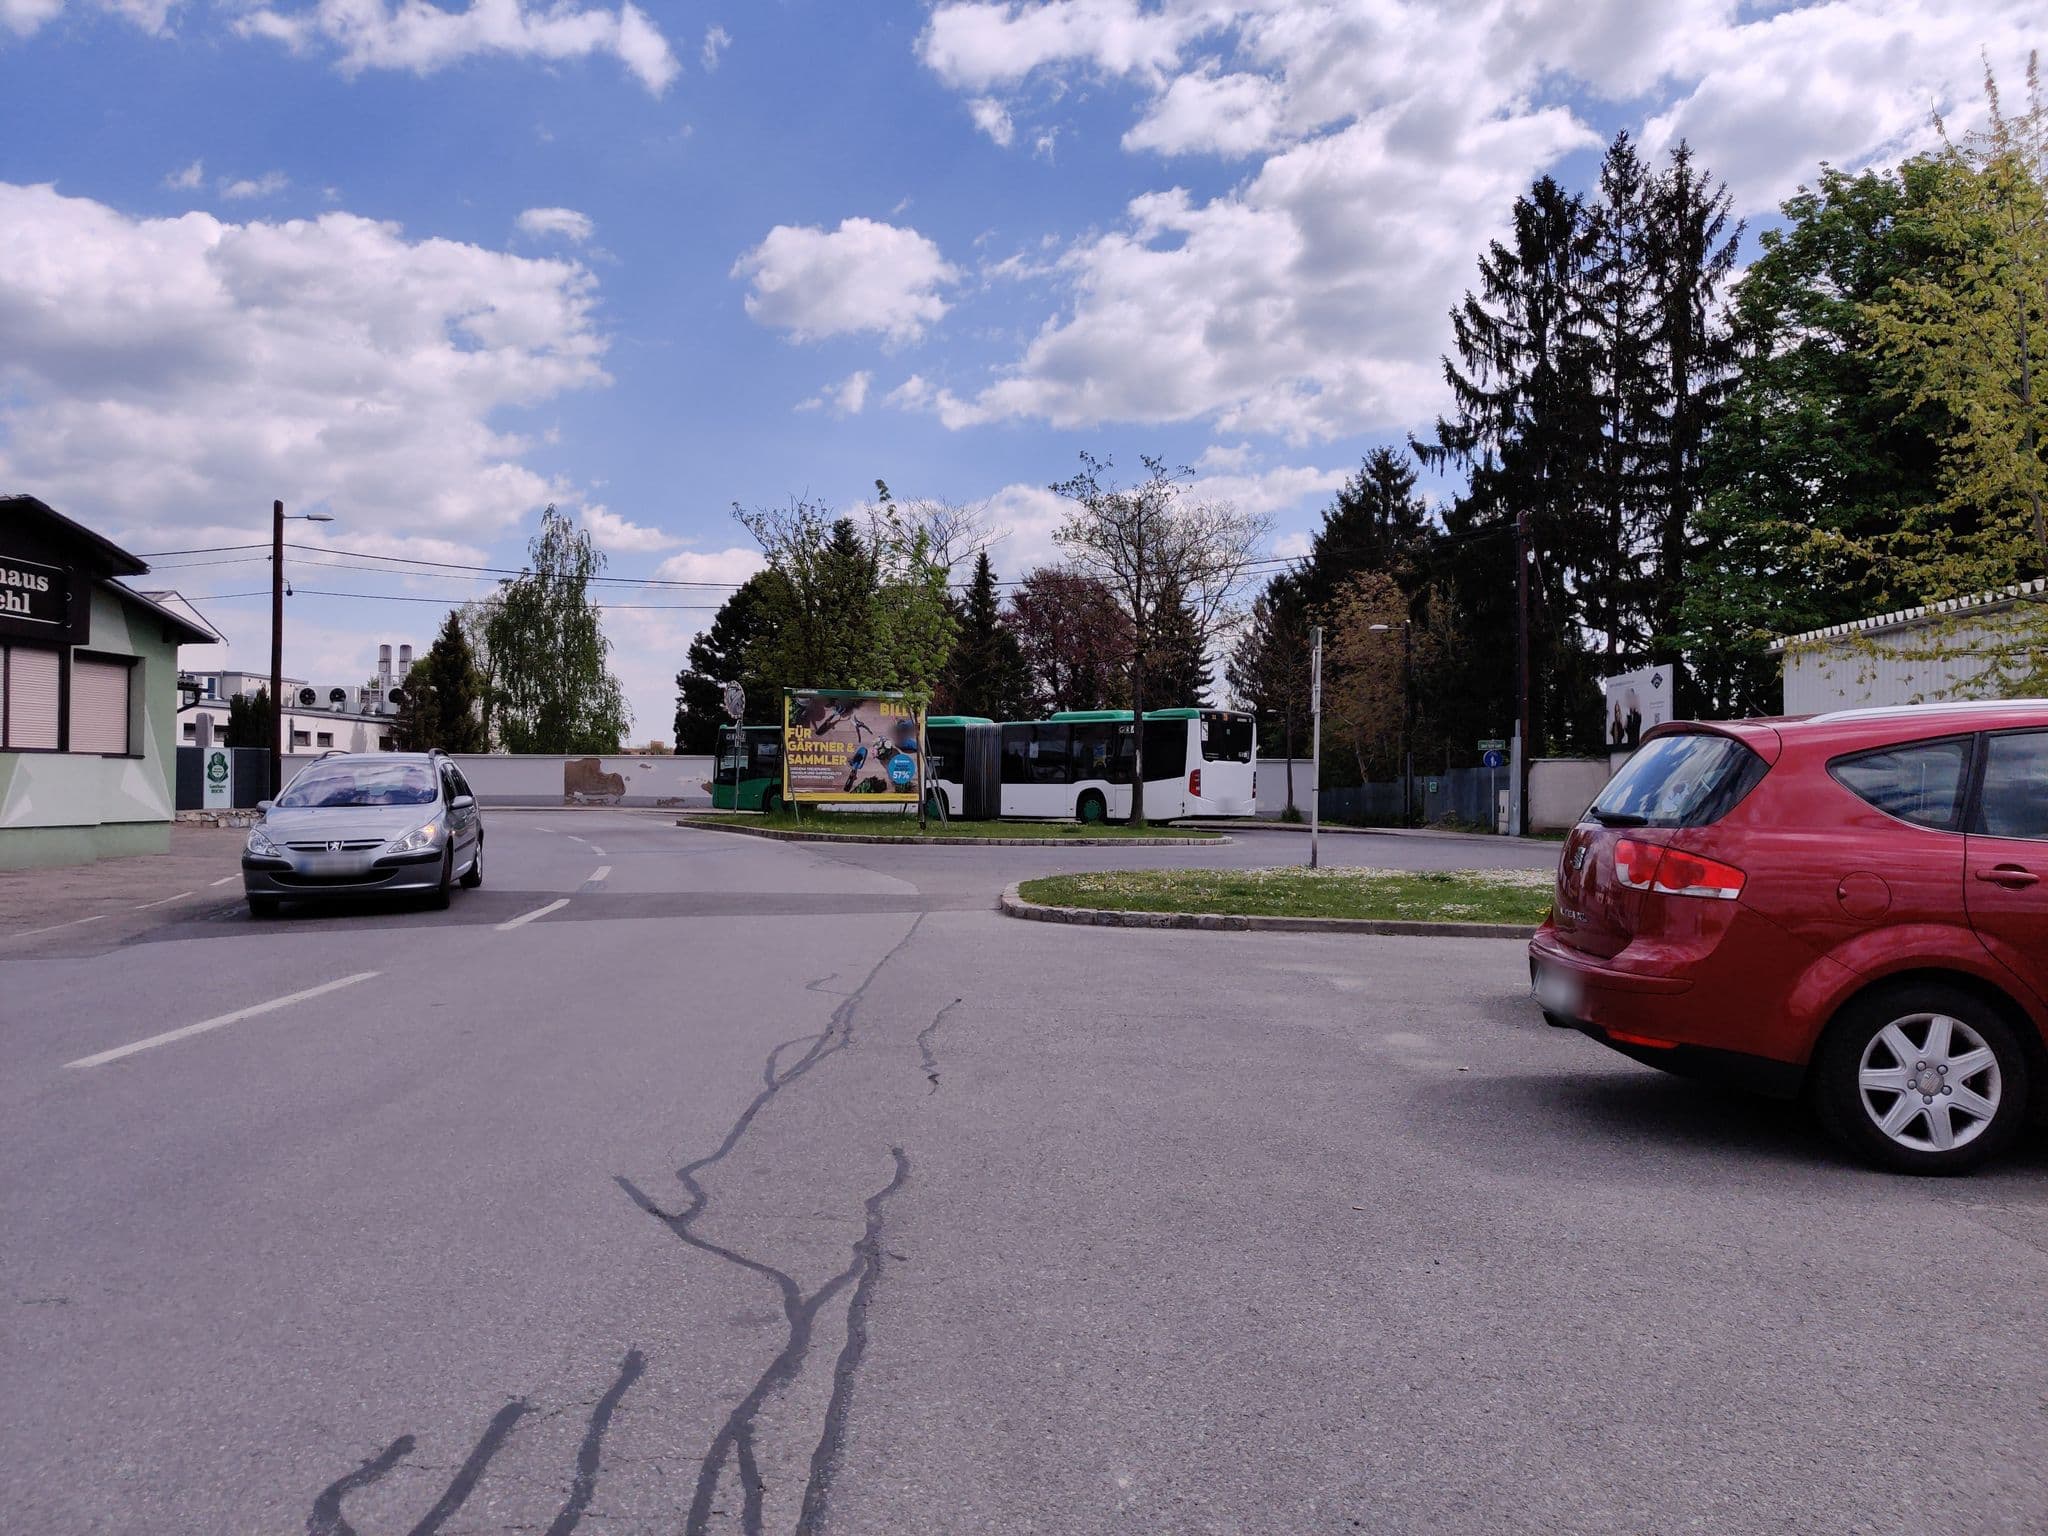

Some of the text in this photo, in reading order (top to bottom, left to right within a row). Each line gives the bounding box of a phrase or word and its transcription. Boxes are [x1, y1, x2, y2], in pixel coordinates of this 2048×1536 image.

[788, 725, 812, 739] FÜR
[788, 739, 855, 753] GÄRTNER &
[788, 754, 848, 766] SAMMLER
